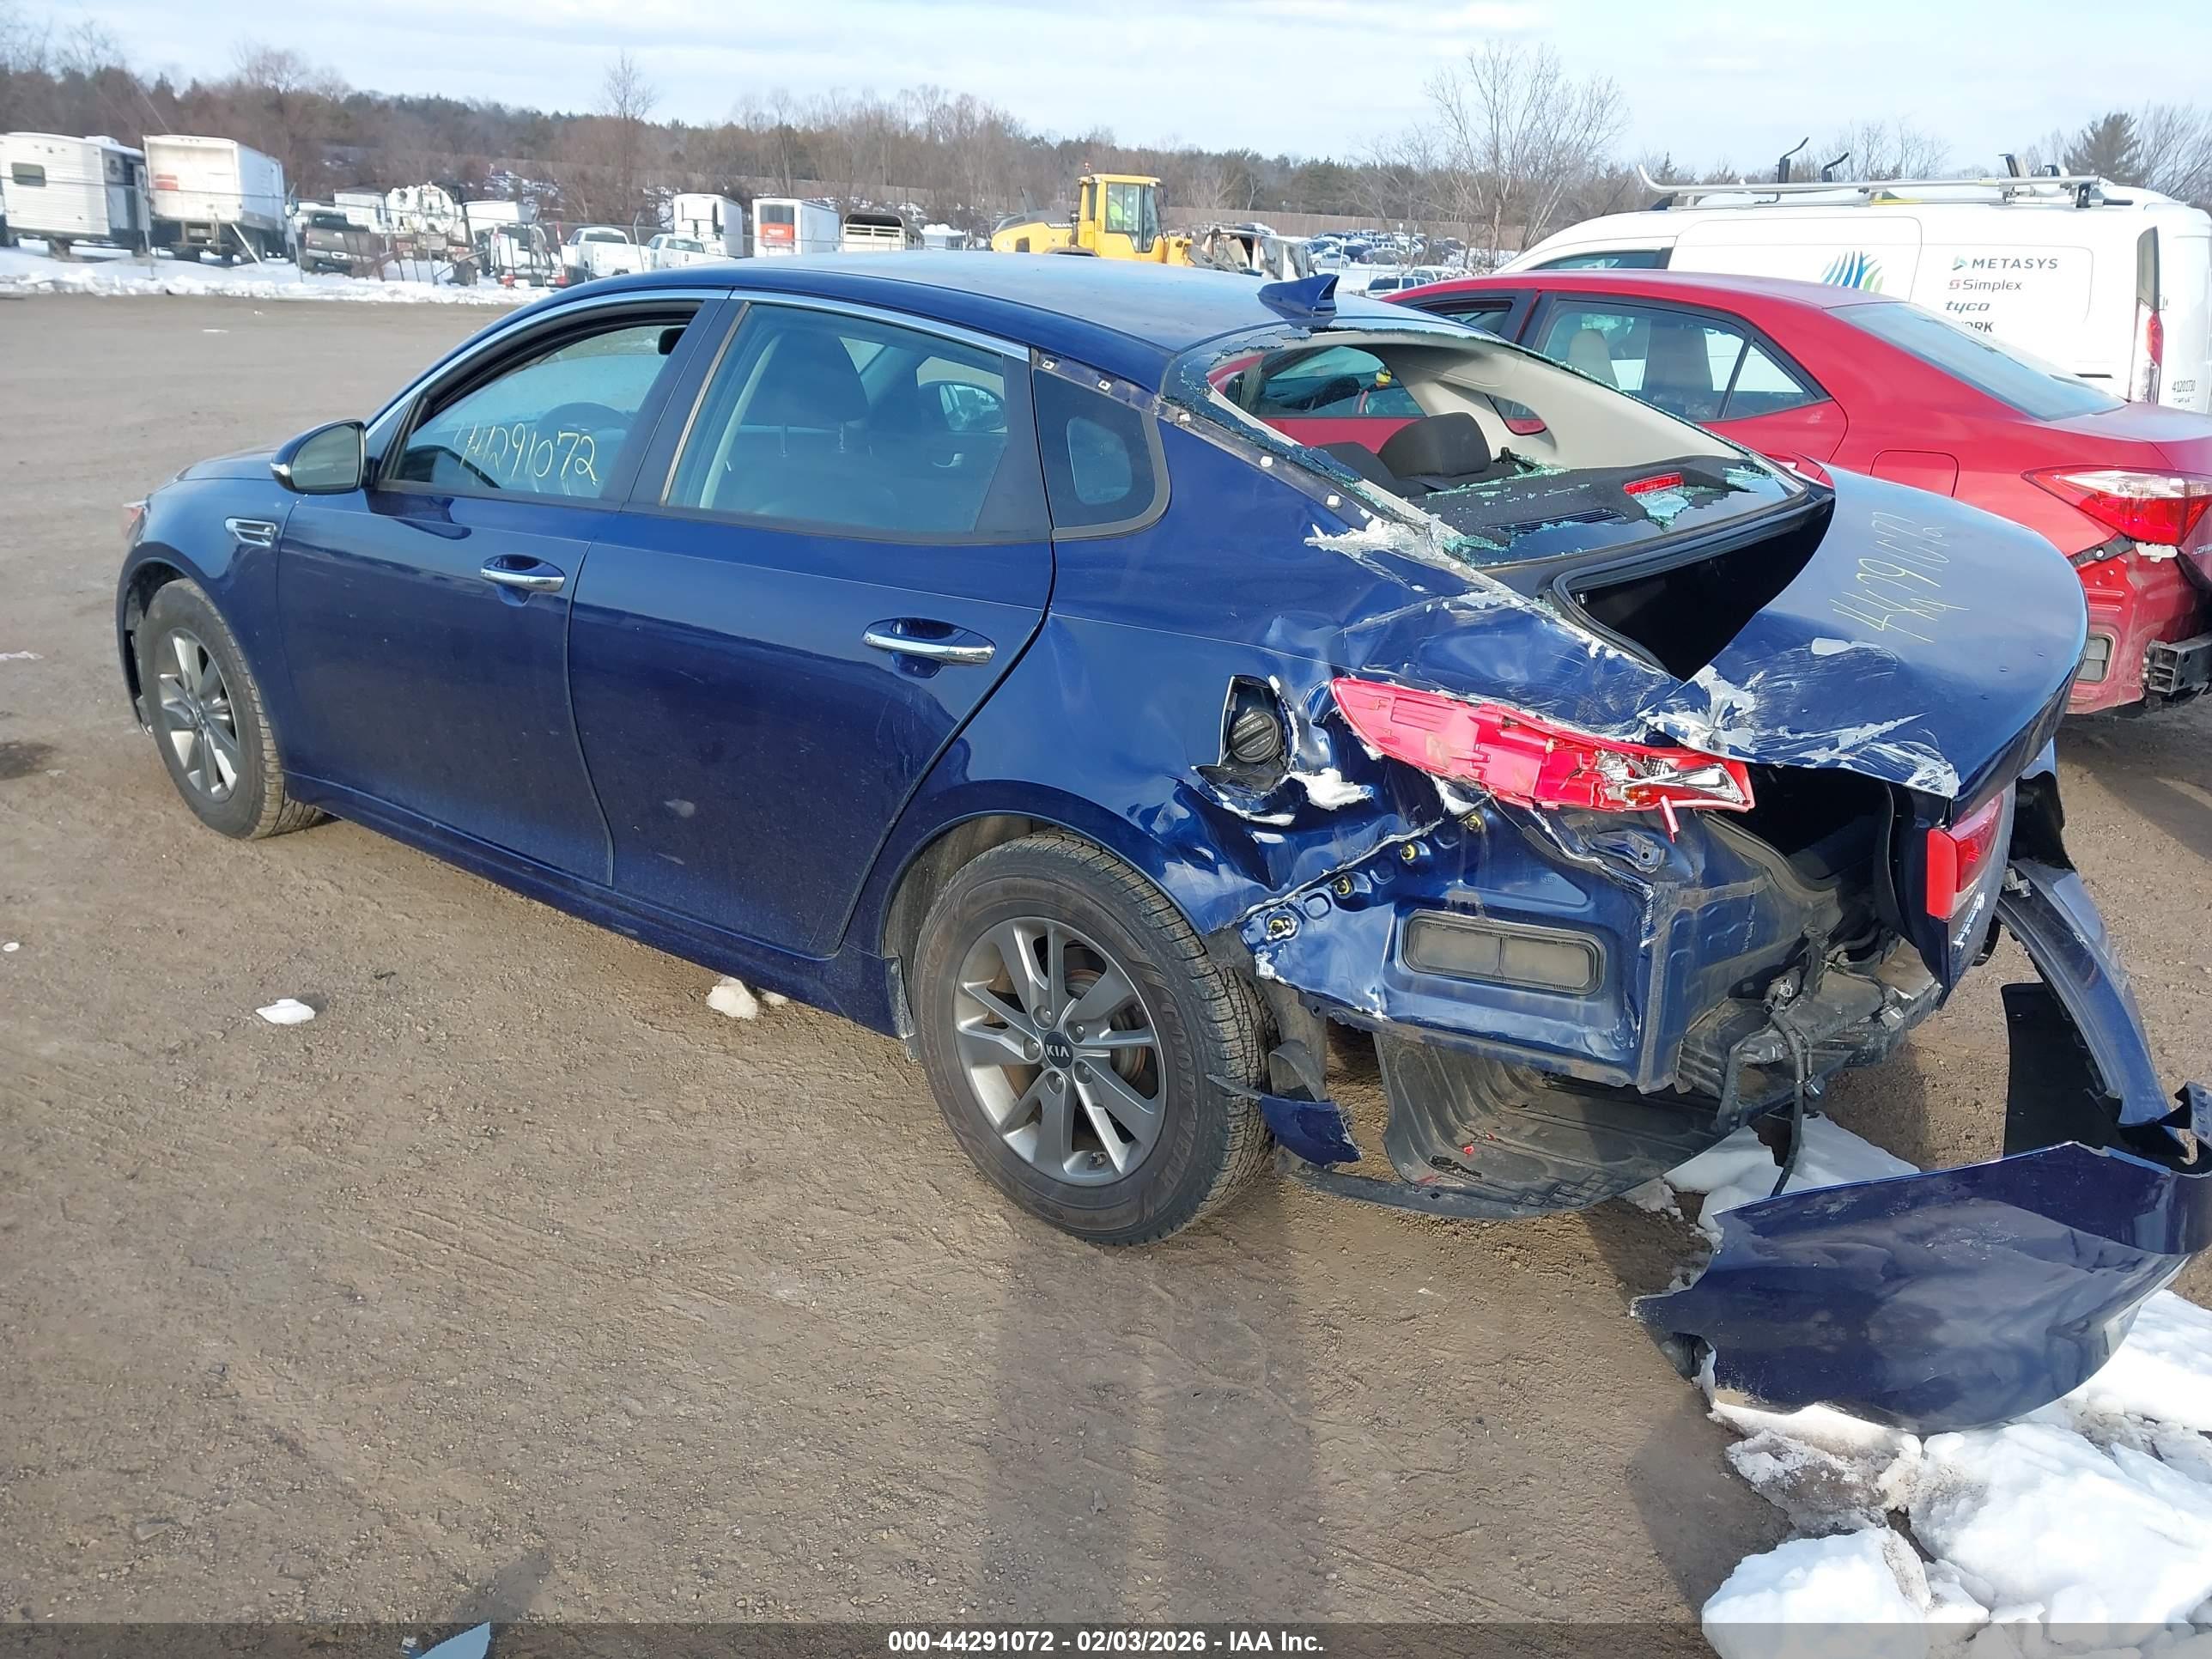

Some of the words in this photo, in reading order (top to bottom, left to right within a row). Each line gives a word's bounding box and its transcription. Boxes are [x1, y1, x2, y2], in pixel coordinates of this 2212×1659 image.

[1972, 258, 2058, 270] METASYS
[1962, 278, 2023, 293] Simplex
[1945, 301, 1991, 314] tyco
[1045, 1043, 1070, 1058] KIA
